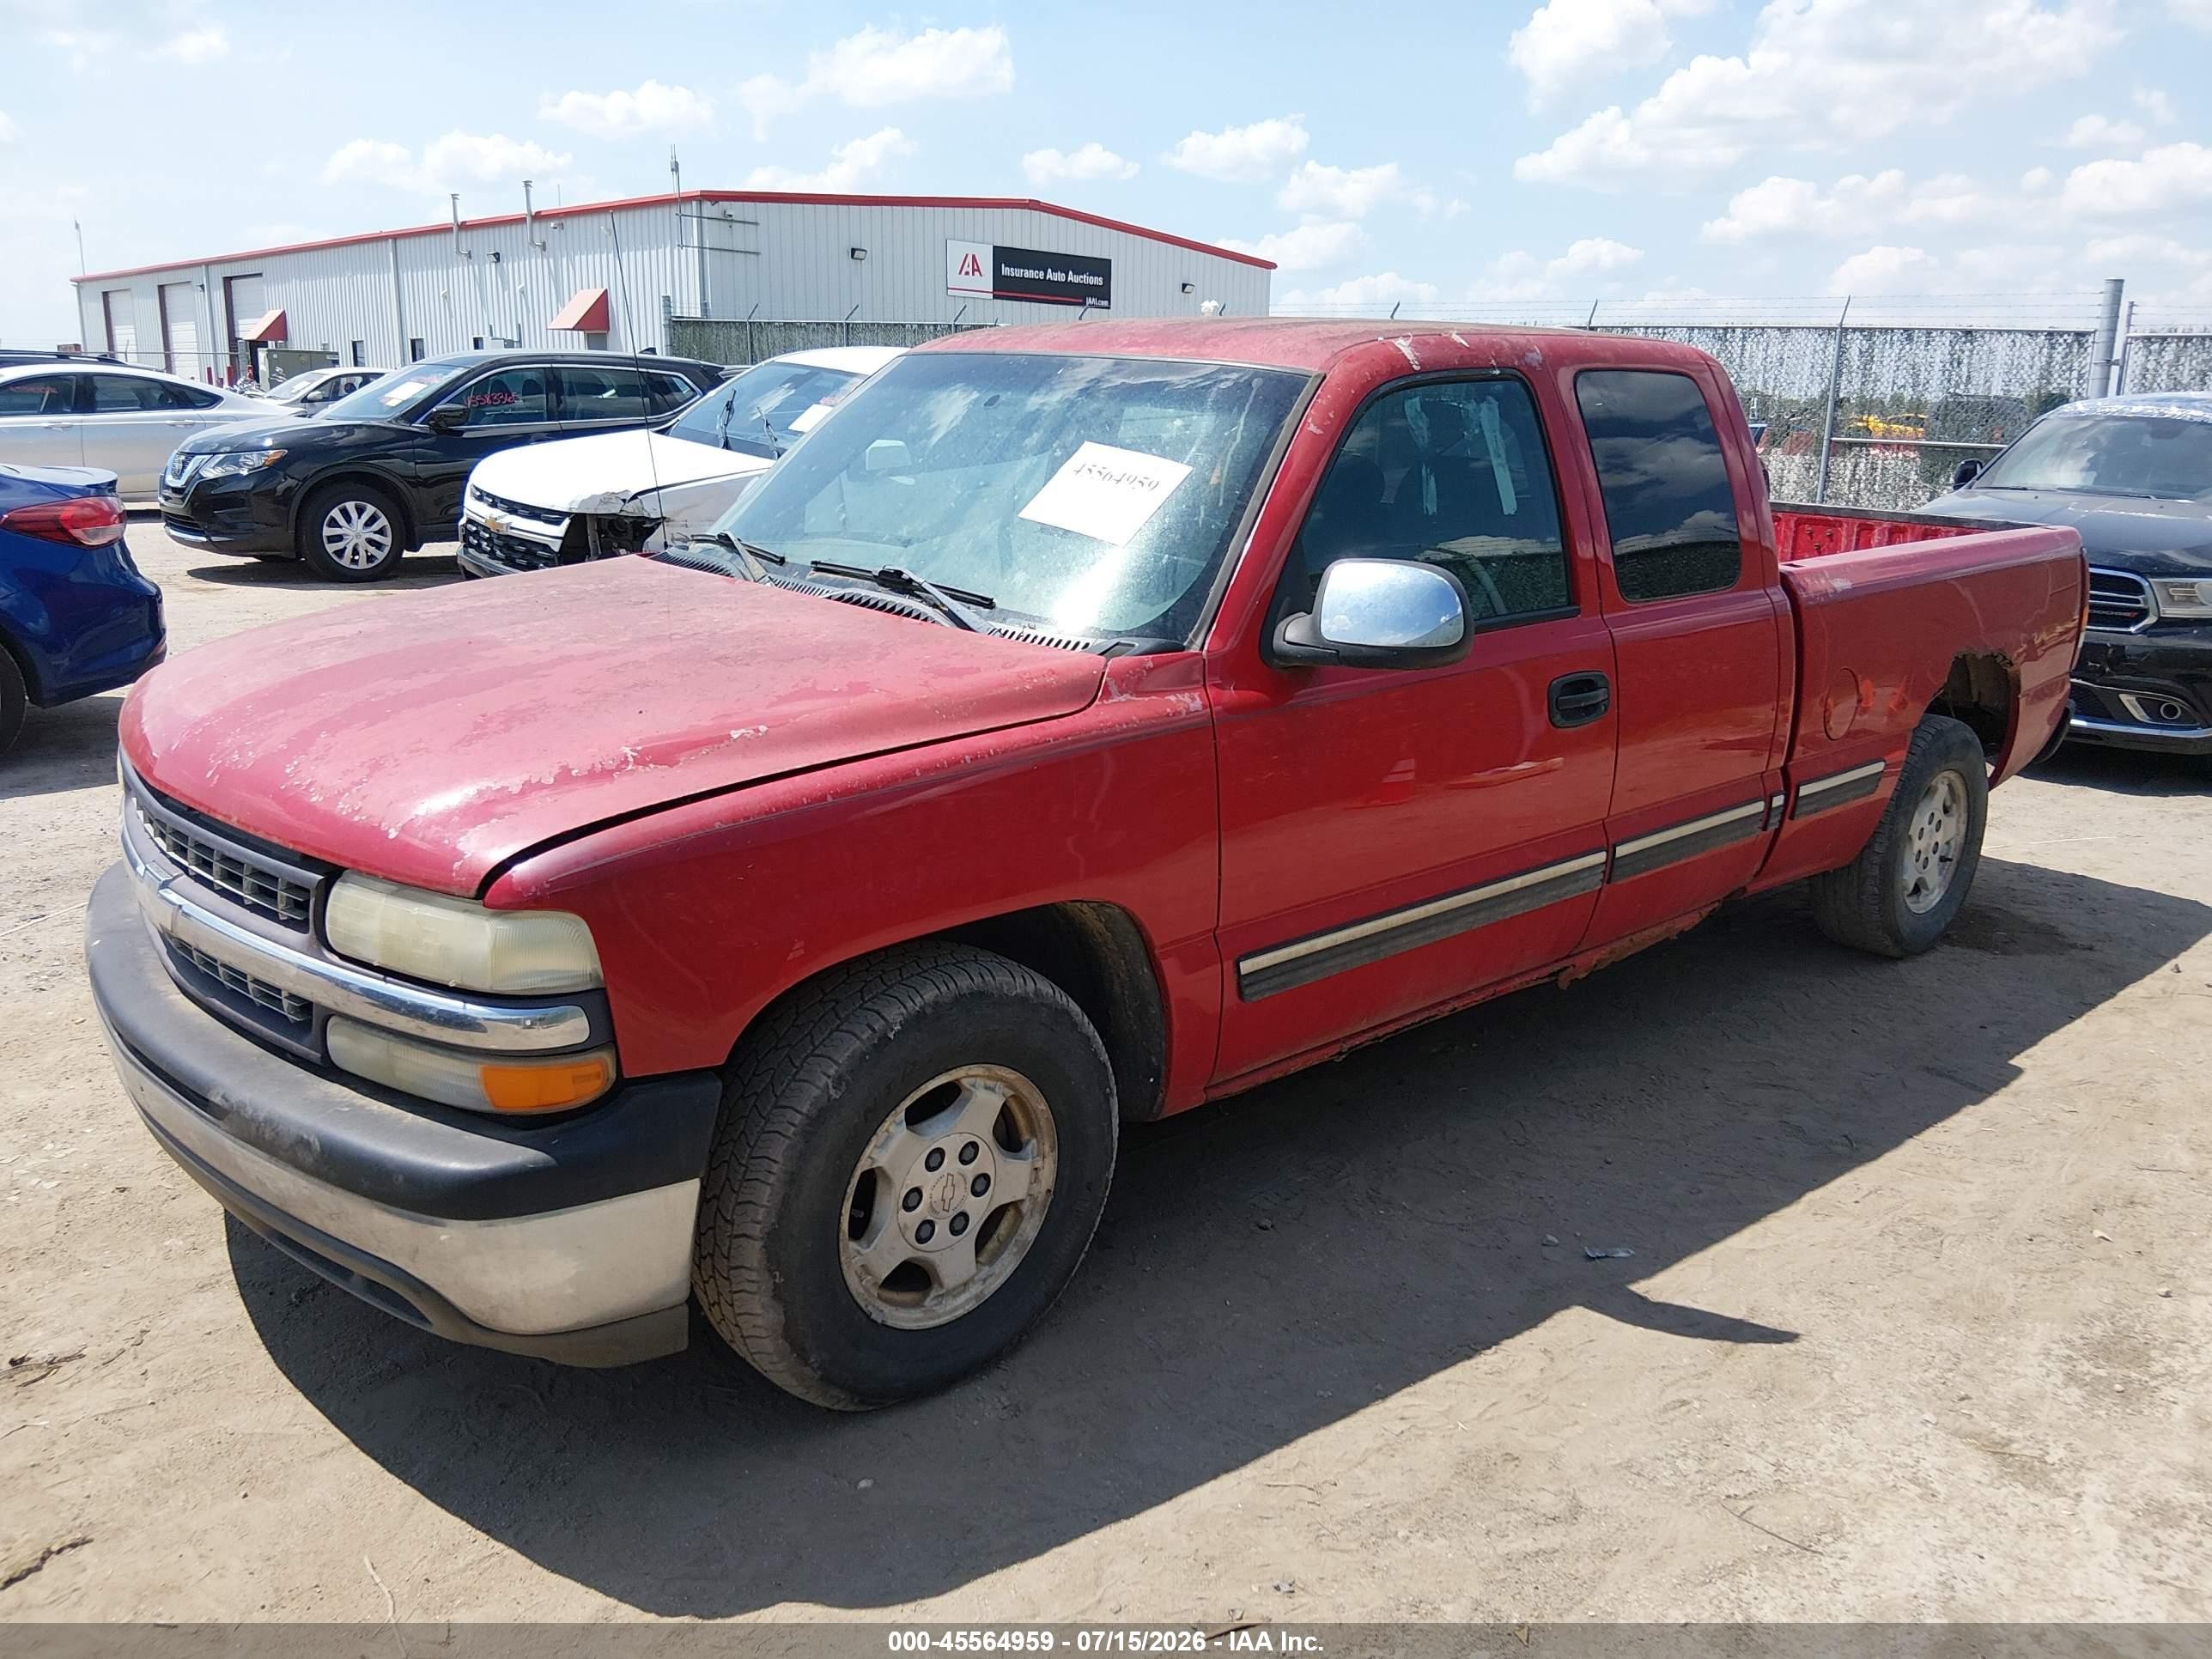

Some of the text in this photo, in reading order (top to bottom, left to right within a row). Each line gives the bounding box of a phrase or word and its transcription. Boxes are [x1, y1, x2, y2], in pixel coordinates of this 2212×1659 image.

[1001, 262, 1104, 286] Insurance Auto Auctions
